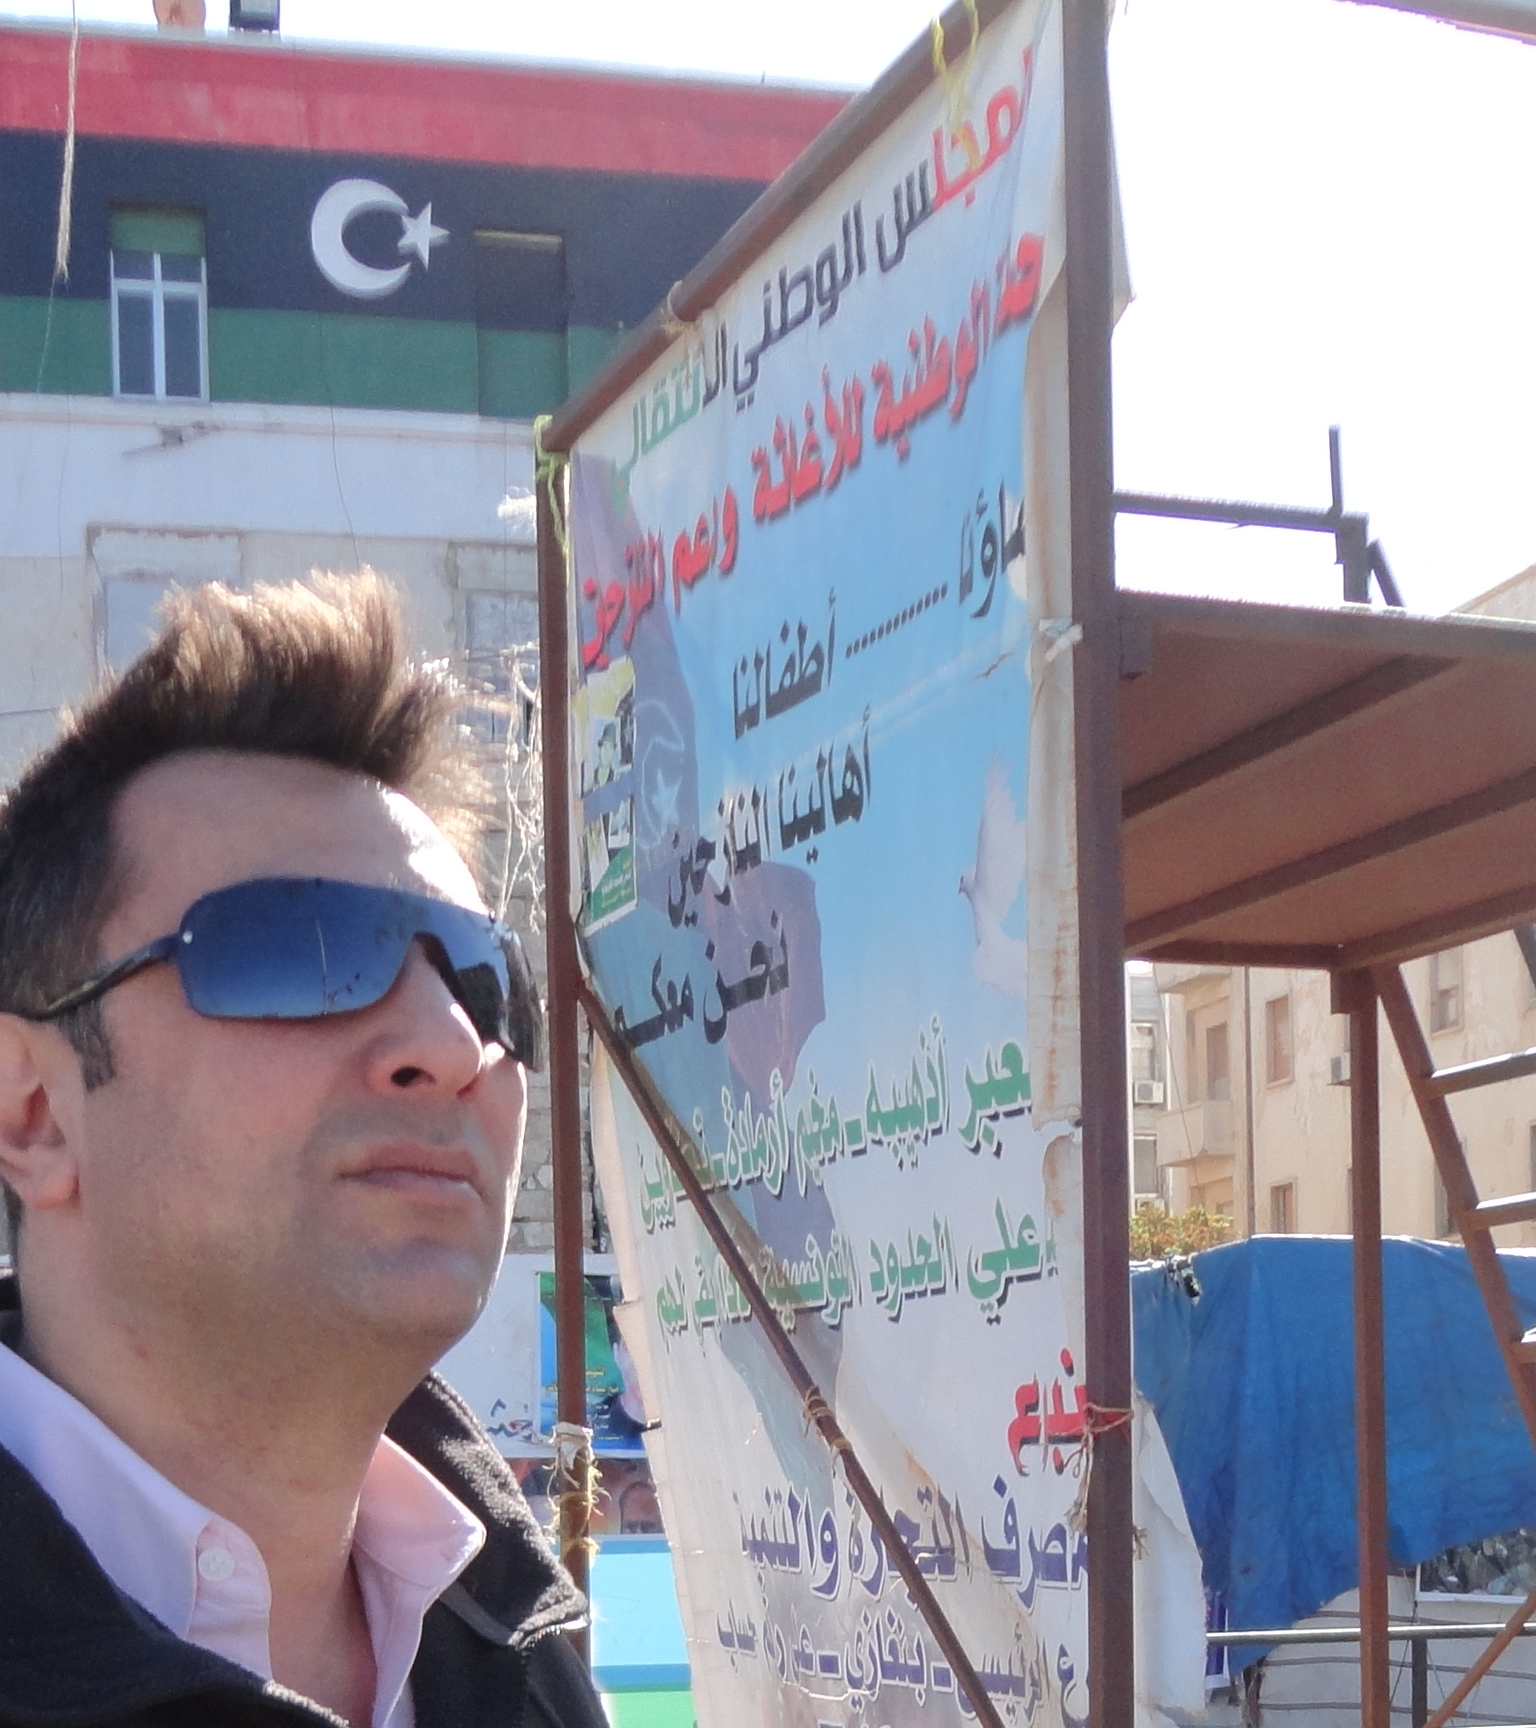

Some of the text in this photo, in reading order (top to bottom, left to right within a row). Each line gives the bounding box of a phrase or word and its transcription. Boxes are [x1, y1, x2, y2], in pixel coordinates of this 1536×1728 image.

[732, 199, 867, 413] الوطني
[703, 910, 789, 1044] نحن
[960, 1037, 1032, 1157] عبر
